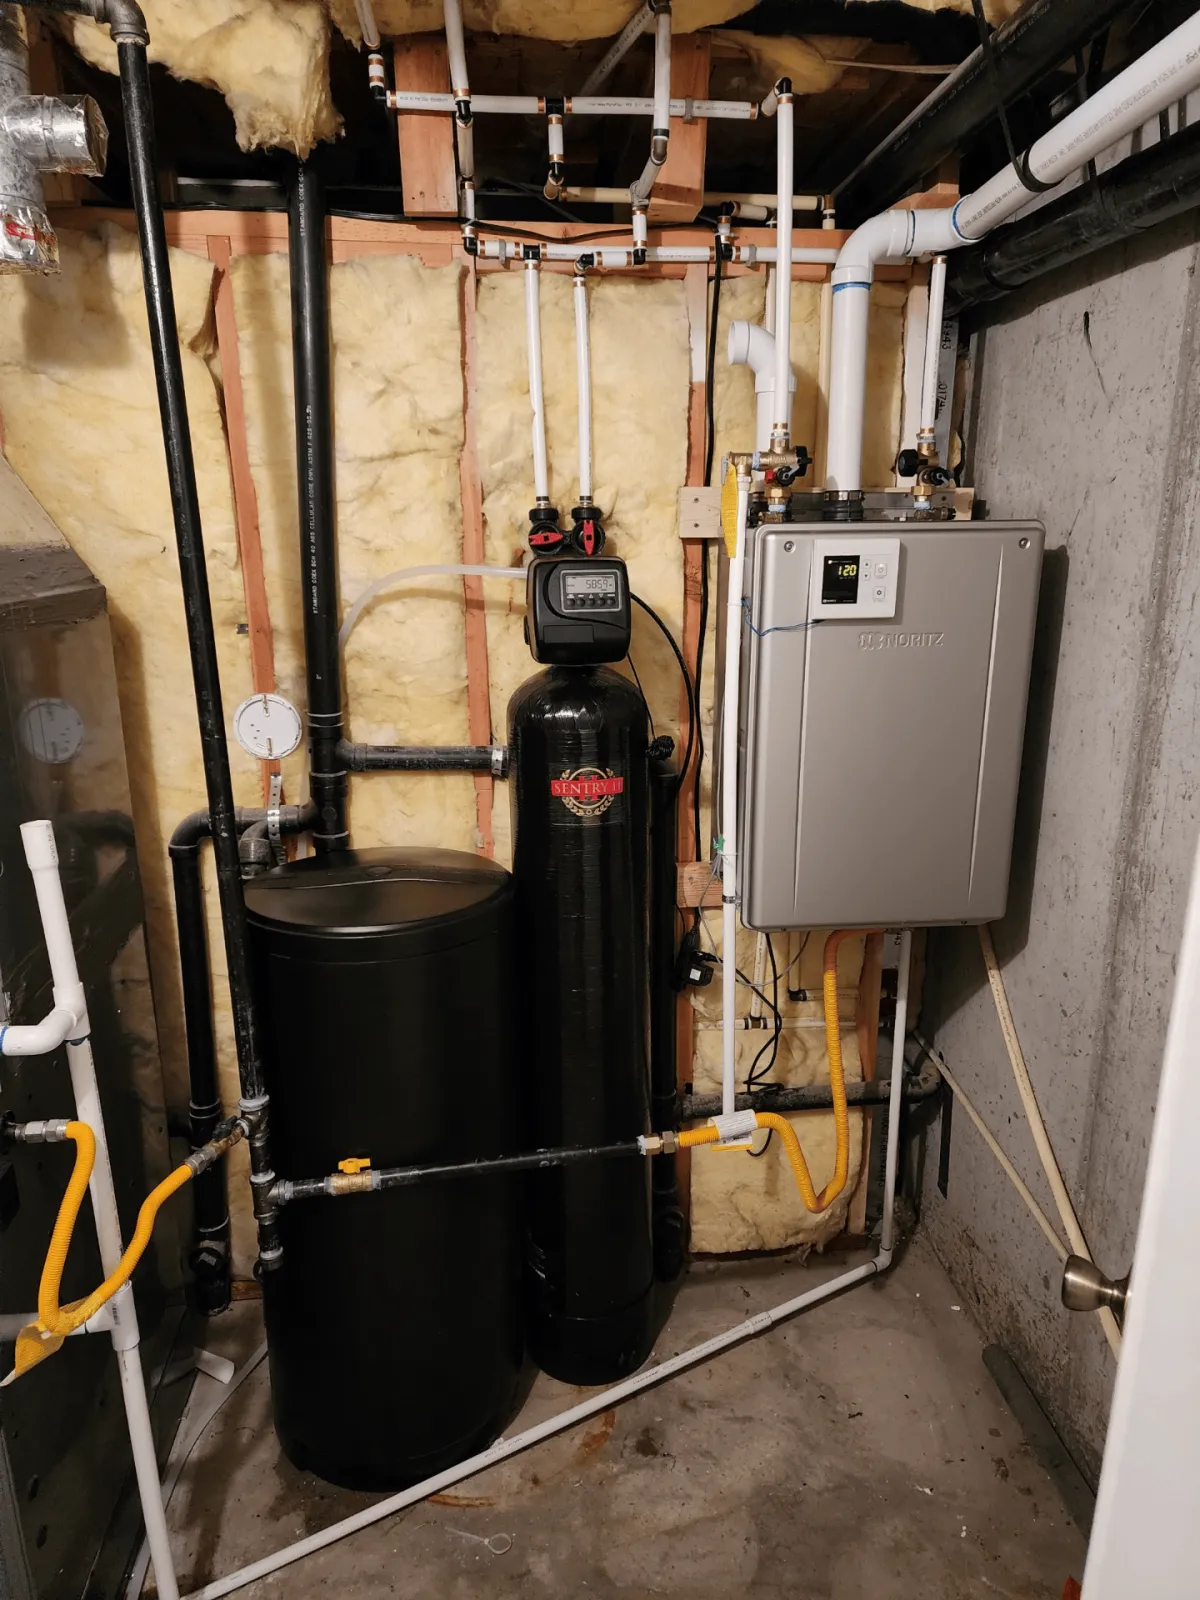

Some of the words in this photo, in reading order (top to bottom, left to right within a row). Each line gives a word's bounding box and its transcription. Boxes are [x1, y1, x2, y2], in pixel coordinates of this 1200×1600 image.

[310, 545, 316, 553] 40
[838, 564, 857, 577] 120
[585, 579, 609, 590] 5859
[884, 631, 945, 648] NORITZ
[554, 782, 610, 795] SENTRY
